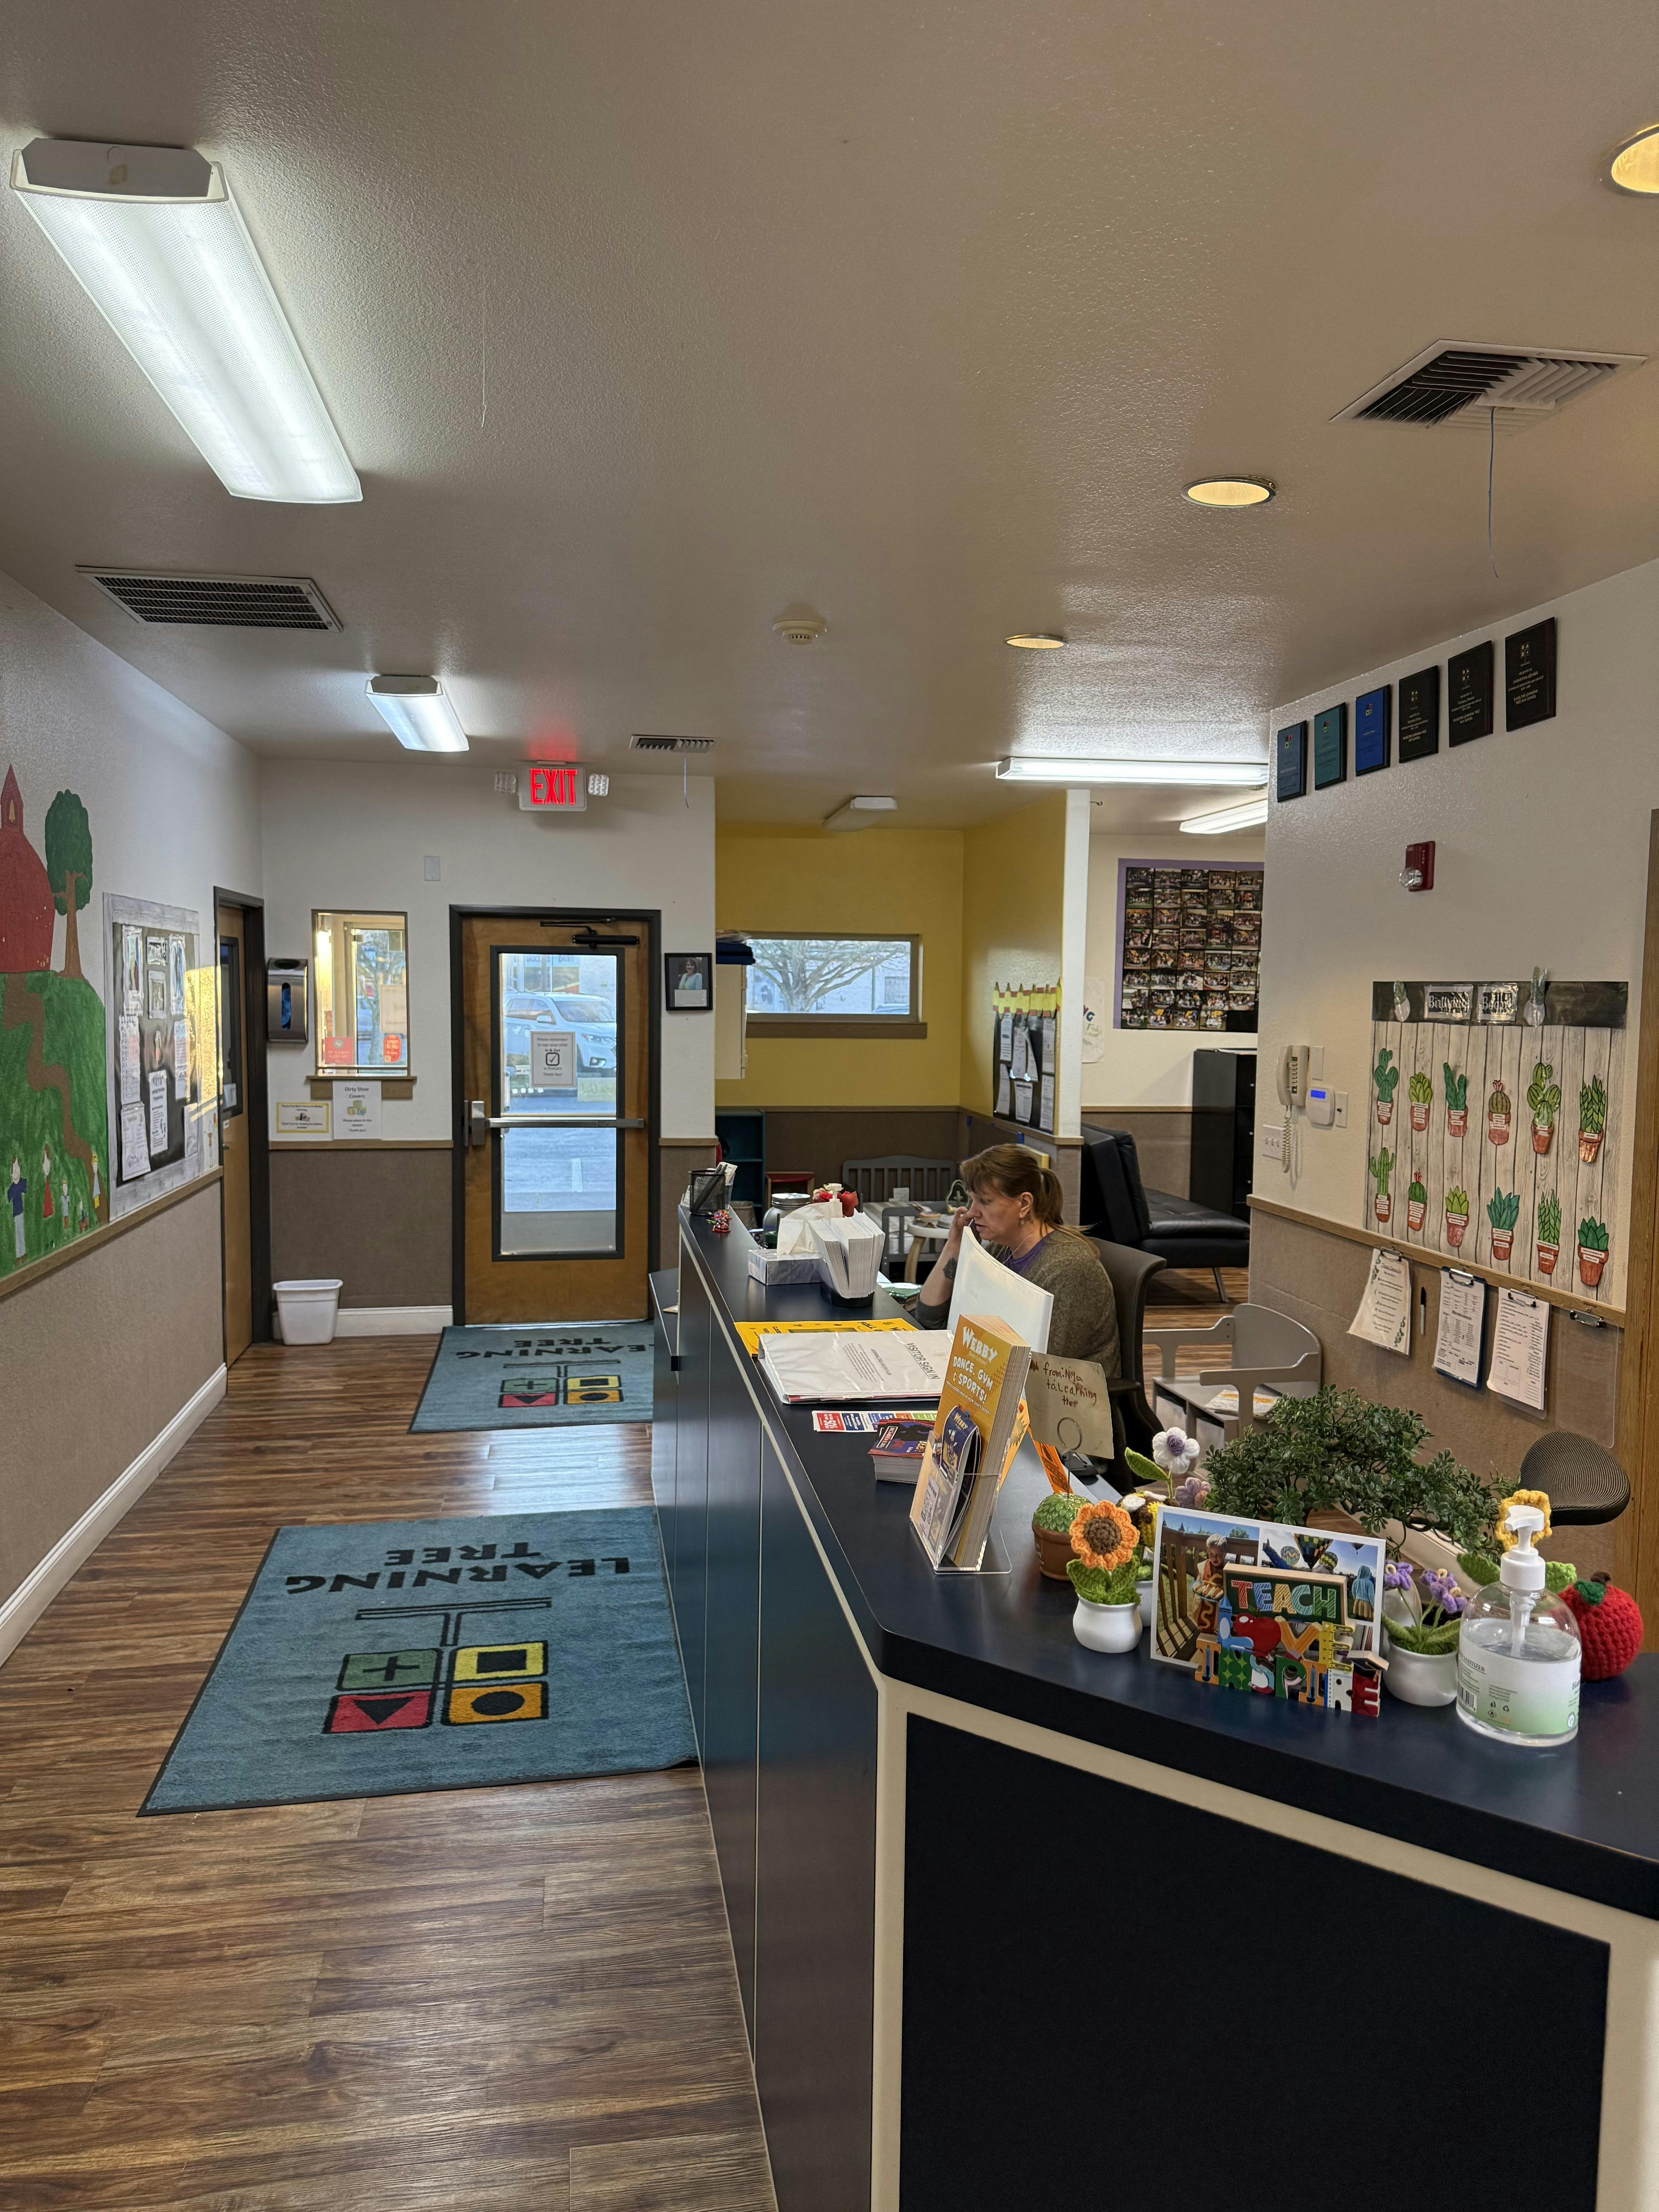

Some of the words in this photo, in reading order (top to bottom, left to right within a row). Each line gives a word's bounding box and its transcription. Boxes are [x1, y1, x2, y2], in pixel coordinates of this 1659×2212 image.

[530, 768, 577, 805] EXIT
[456, 1344, 654, 1359] EARNING
[514, 1338, 611, 1348] TREE
[906, 1343, 926, 1361] VISITOR
[919, 1362, 936, 1373] SIGN
[963, 1326, 998, 1363] WEBBY
[953, 1372, 957, 1382] &
[958, 1372, 987, 1404] SPORTS!
[978, 1369, 993, 1391] GYM
[953, 1412, 968, 1429] WEBBY
[384, 1541, 542, 1566] TREE
[286, 1556, 631, 1595] LEARNING
[1231, 1579, 1337, 1619] TEACH
[1217, 1595, 1355, 1672] LOVE
[1195, 1633, 1382, 1717] INSPIRE
